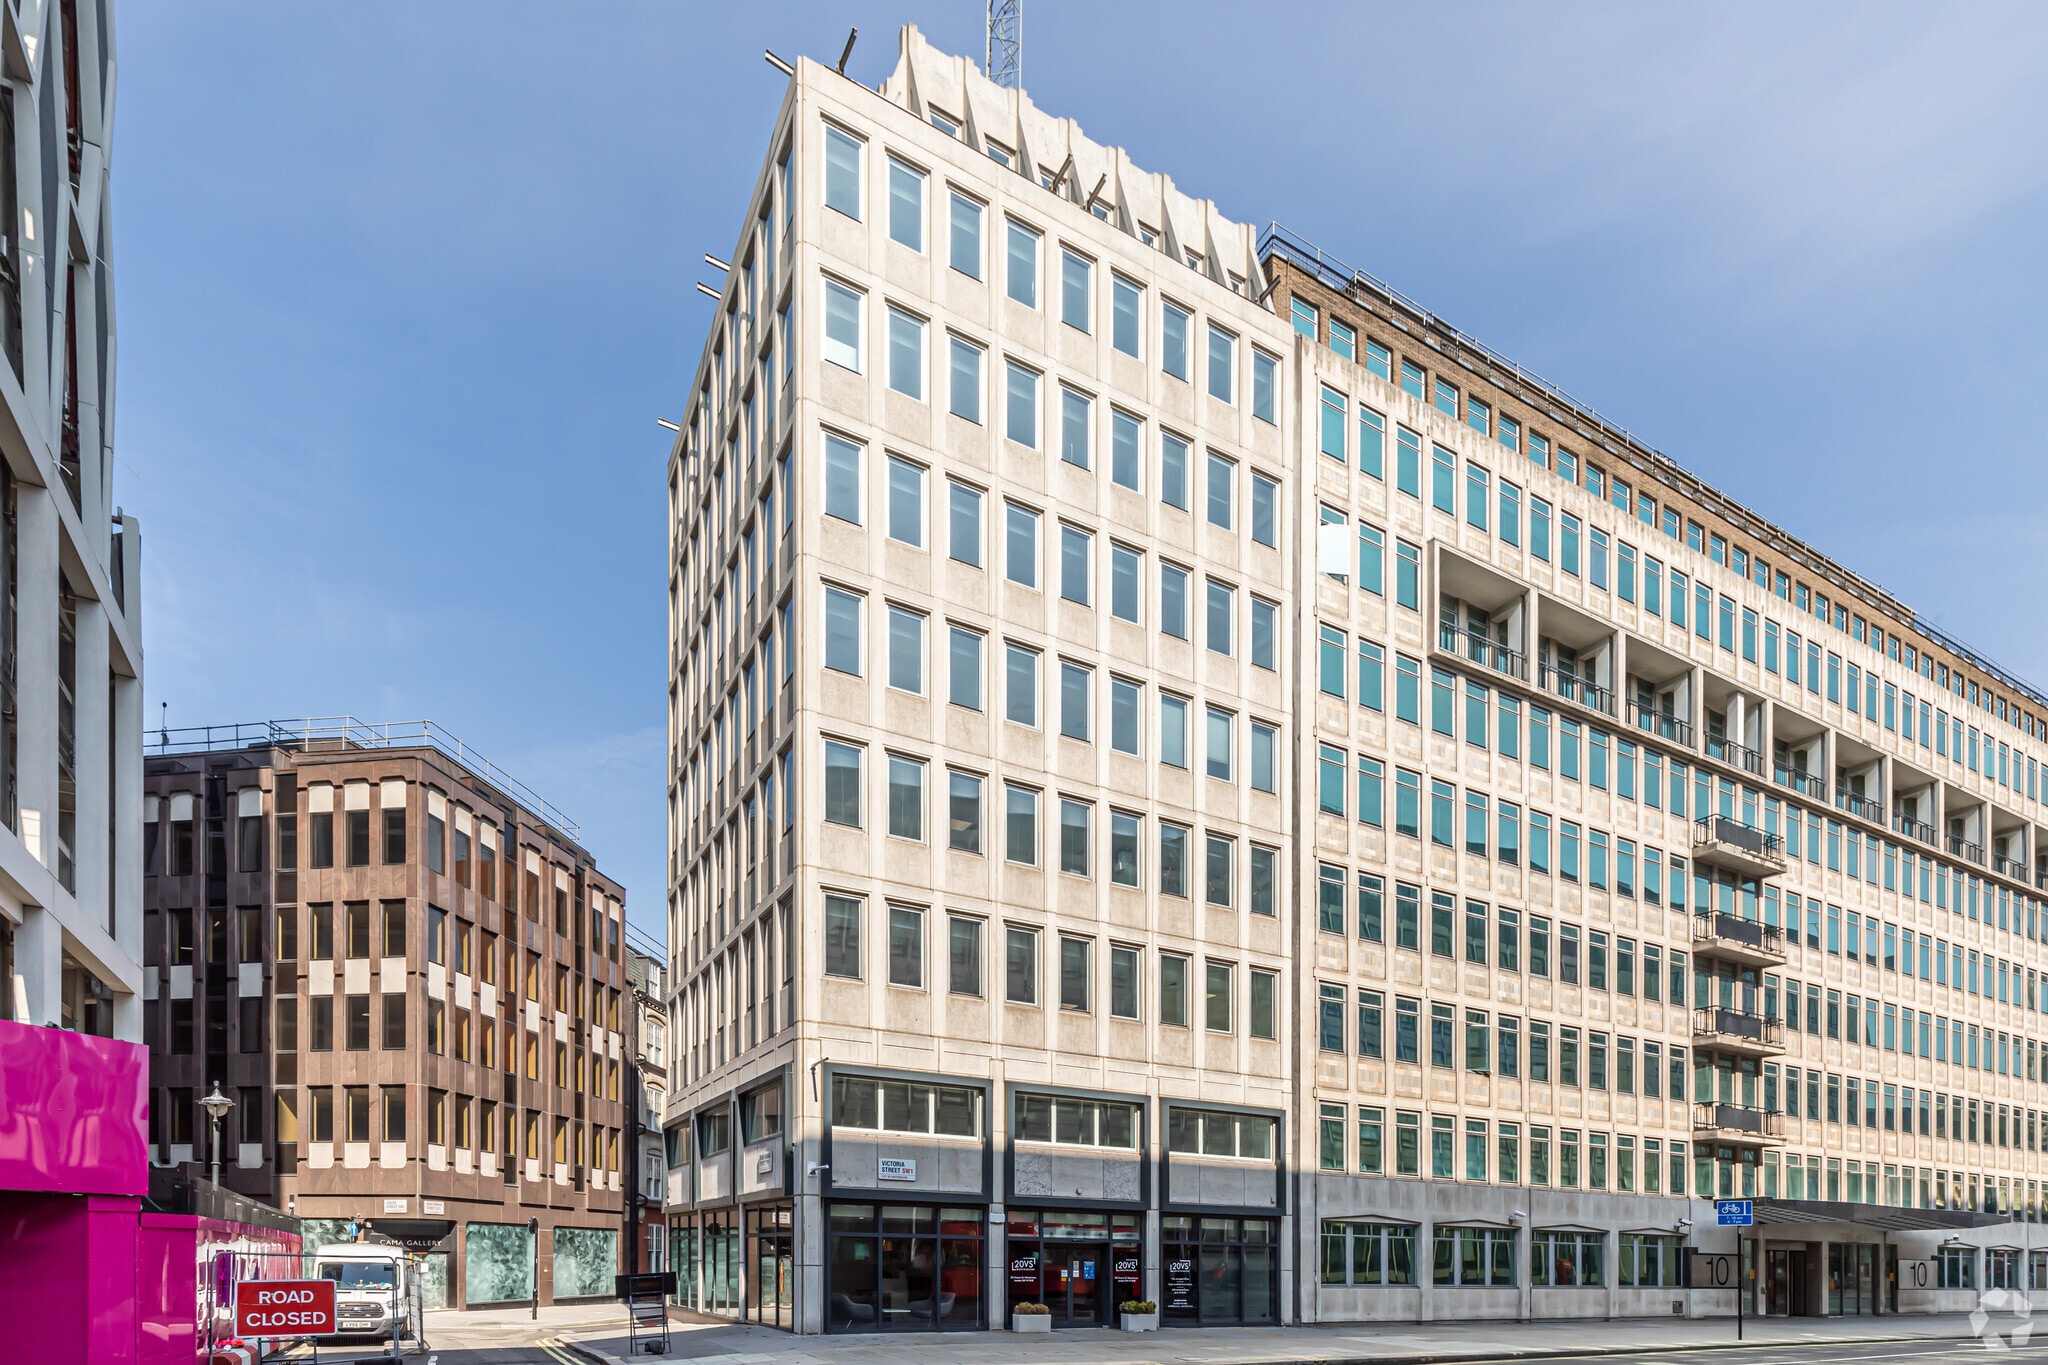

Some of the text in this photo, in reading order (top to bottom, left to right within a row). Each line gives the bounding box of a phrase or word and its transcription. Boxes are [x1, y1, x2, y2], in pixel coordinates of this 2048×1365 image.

[1014, 1260, 1034, 1268] 20VS
[1118, 1261, 1136, 1269] 20VS
[1172, 1262, 1189, 1270] 20VS
[1706, 1256, 1729, 1286] 10
[1910, 1262, 1927, 1287] 10
[258, 1290, 314, 1304] ROAD
[246, 1312, 326, 1327] CLOSED
